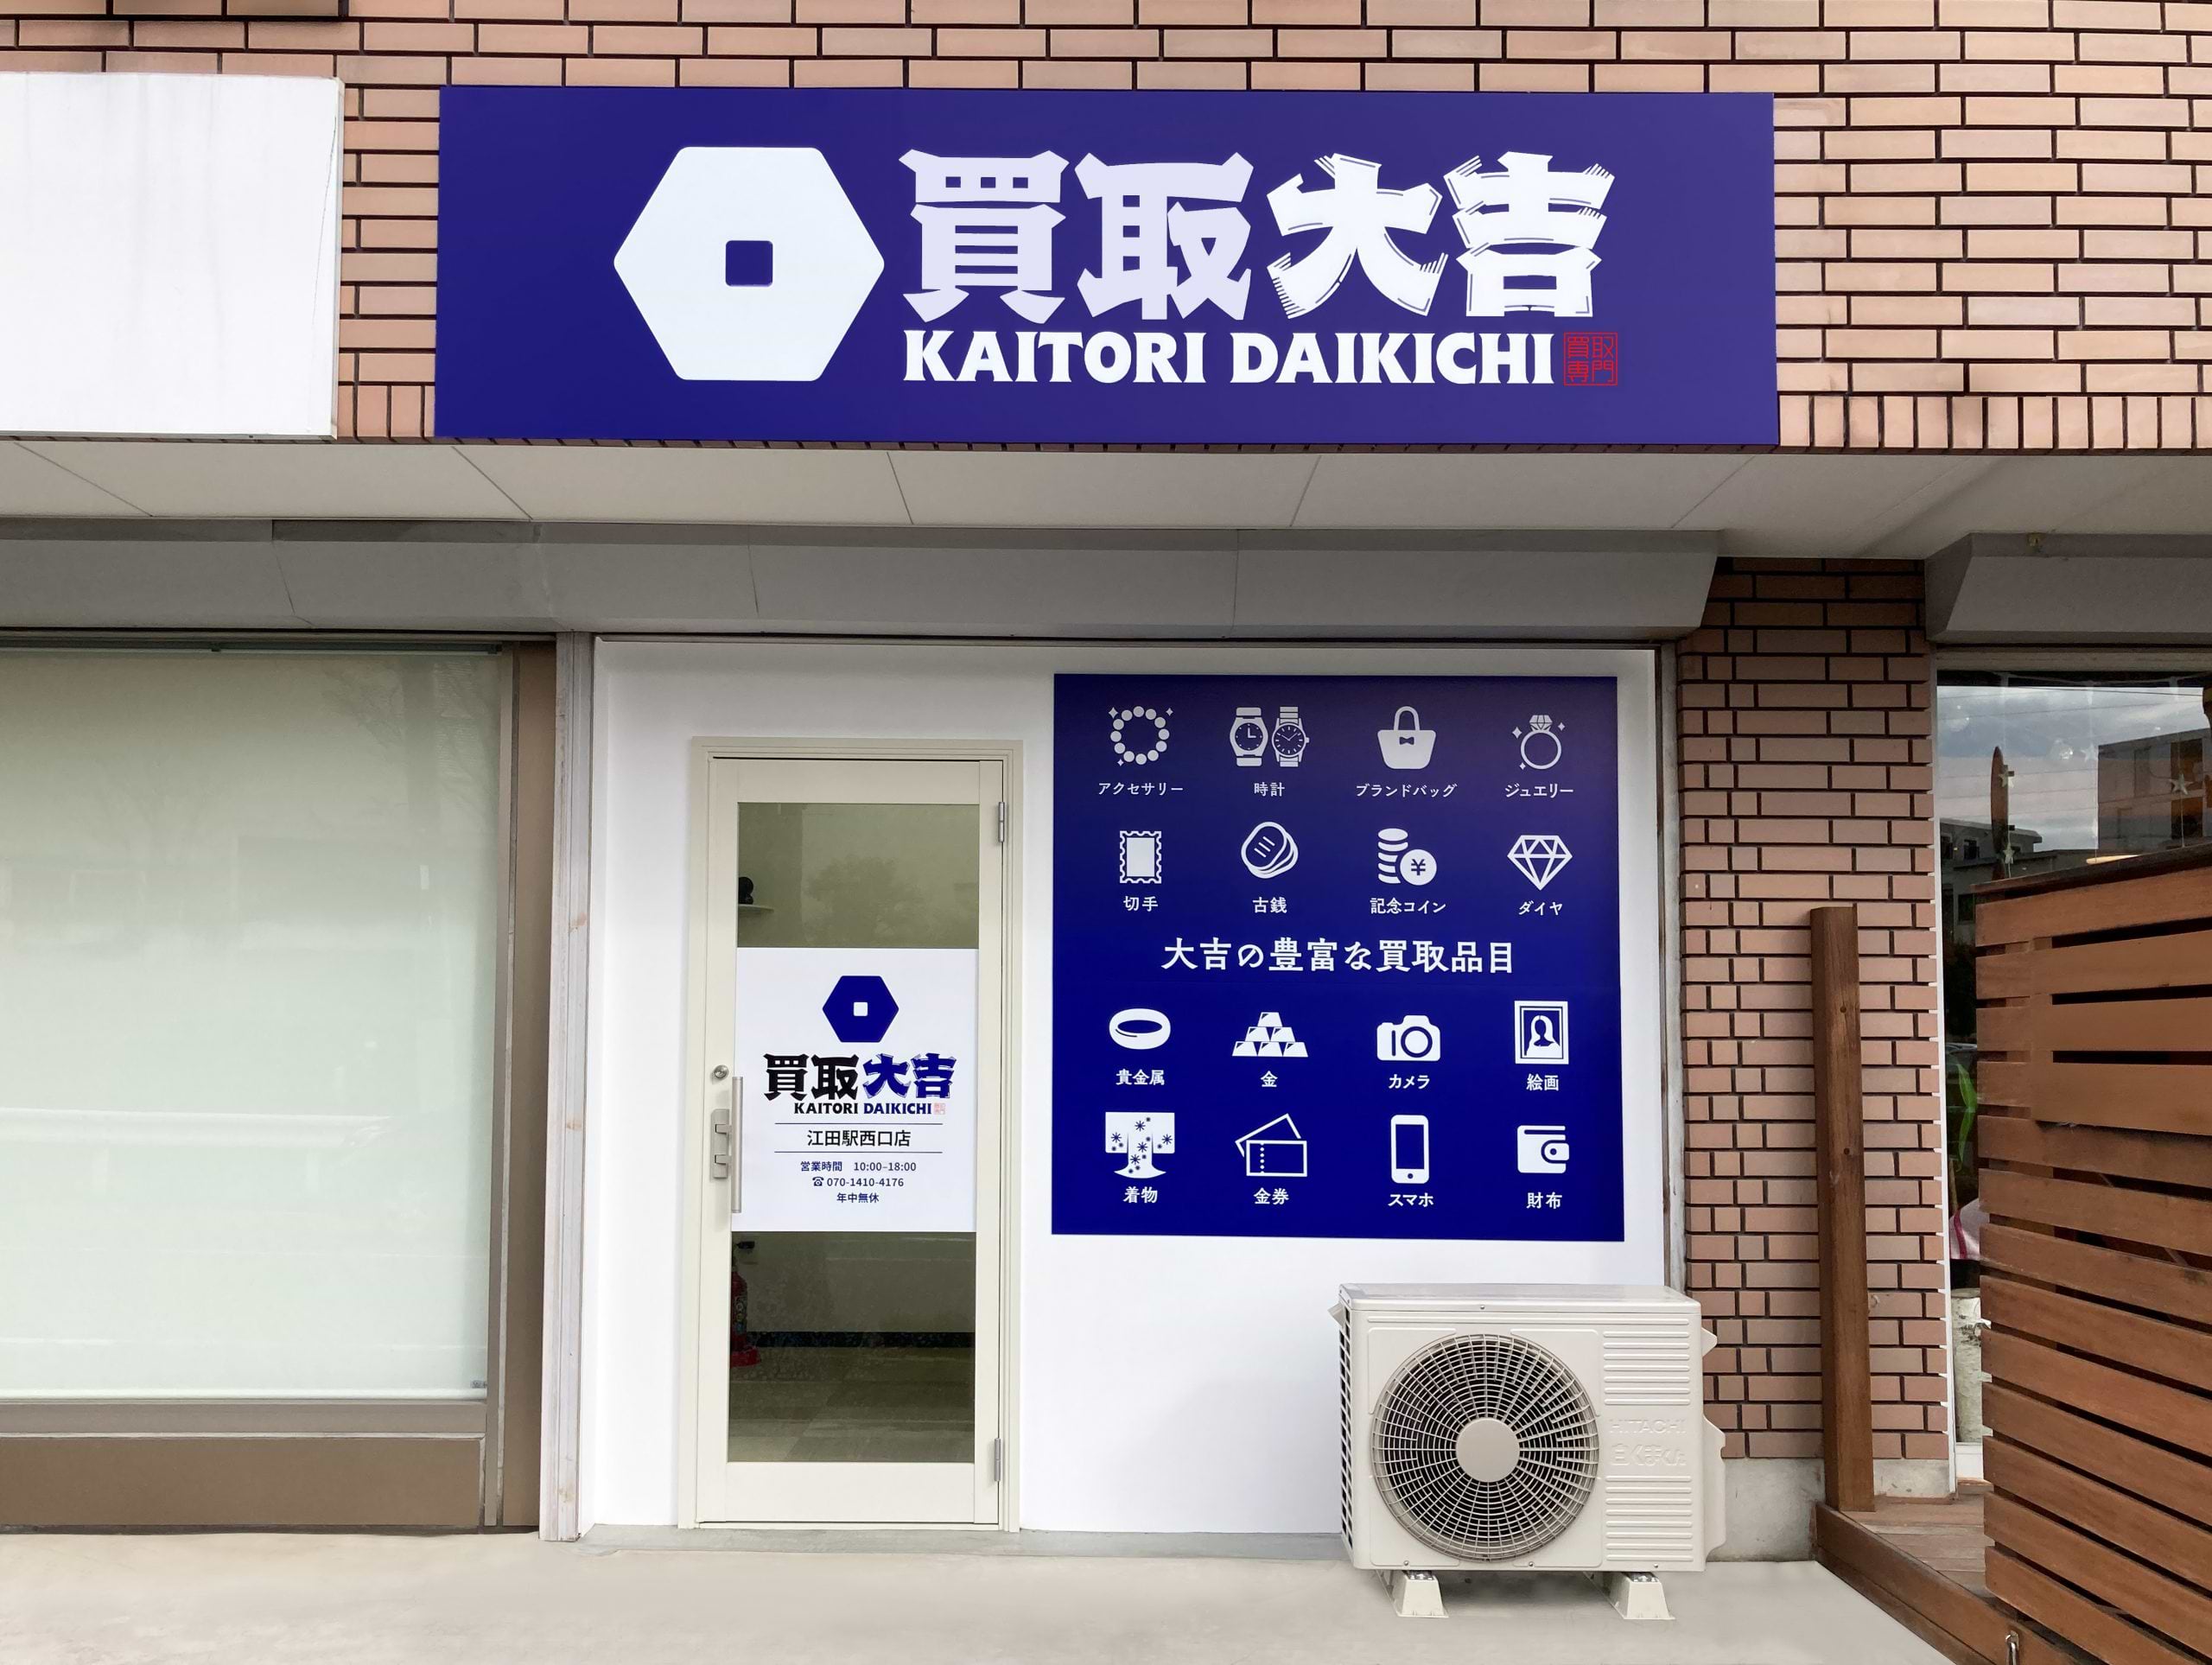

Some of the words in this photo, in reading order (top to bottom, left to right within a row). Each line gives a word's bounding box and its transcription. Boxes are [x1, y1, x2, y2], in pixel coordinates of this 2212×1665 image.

[899, 149, 1615, 323] 買取大吉
[1567, 335, 1614, 359] 買取
[904, 330, 1206, 383] KAITORI
[1230, 333, 1554, 384] DAIKICHI
[1099, 783, 1183, 795] アクセサリー
[1255, 782, 1285, 796] 時計
[1357, 784, 1457, 797] ブランドバッグ
[1505, 784, 1573, 798] ジュエリー
[1123, 896, 1158, 912] 切手
[1253, 897, 1287, 913] 古銭
[1370, 898, 1446, 913] 記念コイン
[1519, 900, 1562, 915] ダイヤ
[1161, 937, 1511, 973] 大吉の豊富な買取品目
[763, 1053, 957, 1100] 買取大吉
[1116, 1069, 1164, 1085] 貴金属
[1261, 1071, 1277, 1087] 金
[1389, 1074, 1429, 1089] カメラ
[1527, 1074, 1558, 1090] 絵画
[795, 1103, 858, 1114] KAITORI
[864, 1103, 931, 1114] DAIKICHI
[808, 1130, 911, 1147] 江田駅西口店
[801, 1161, 842, 1171] 営業時間
[837, 1193, 879, 1203] 年中無休
[1123, 1186, 1157, 1203] 着物
[1254, 1188, 1288, 1204] 金券
[1389, 1193, 1433, 1207] スマホ
[1527, 1192, 1562, 1209] 財布
[1609, 1420, 1686, 1433] HITACHI
